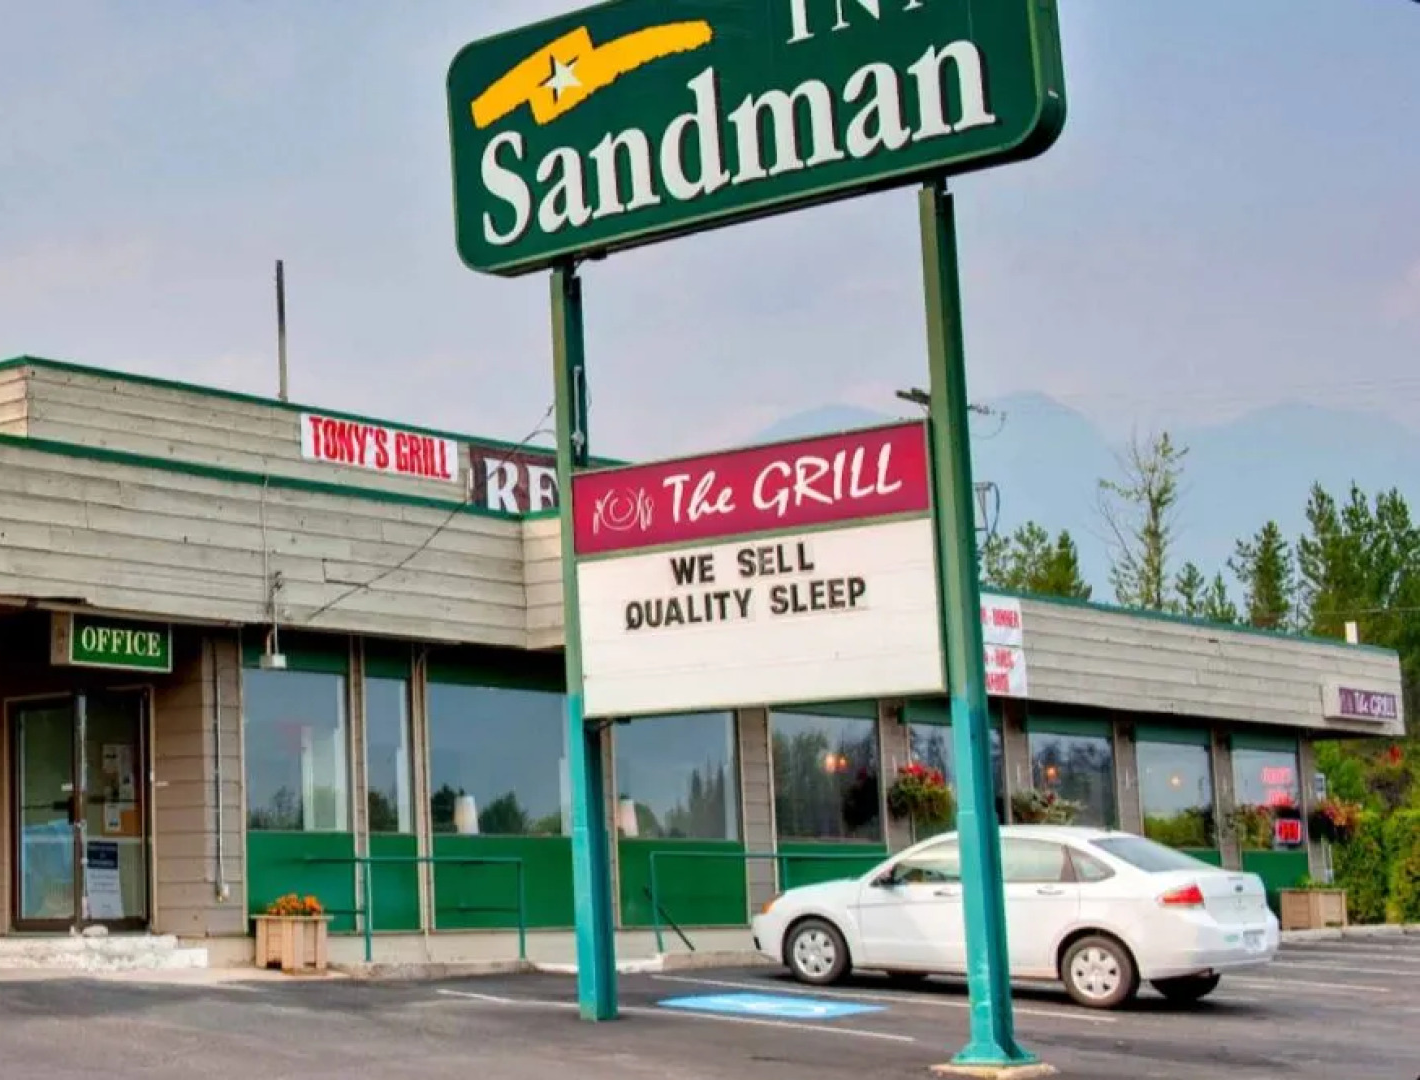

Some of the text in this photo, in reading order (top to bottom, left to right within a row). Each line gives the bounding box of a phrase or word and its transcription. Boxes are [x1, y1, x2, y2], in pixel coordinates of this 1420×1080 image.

[480, 39, 996, 246] Sandman
[309, 415, 451, 480] TONY'S GRILL
[662, 442, 902, 523] The GRILL
[670, 542, 814, 585] WE SELL
[625, 577, 866, 630] QUALITY SLEEP
[81, 625, 161, 657] OFFICE
